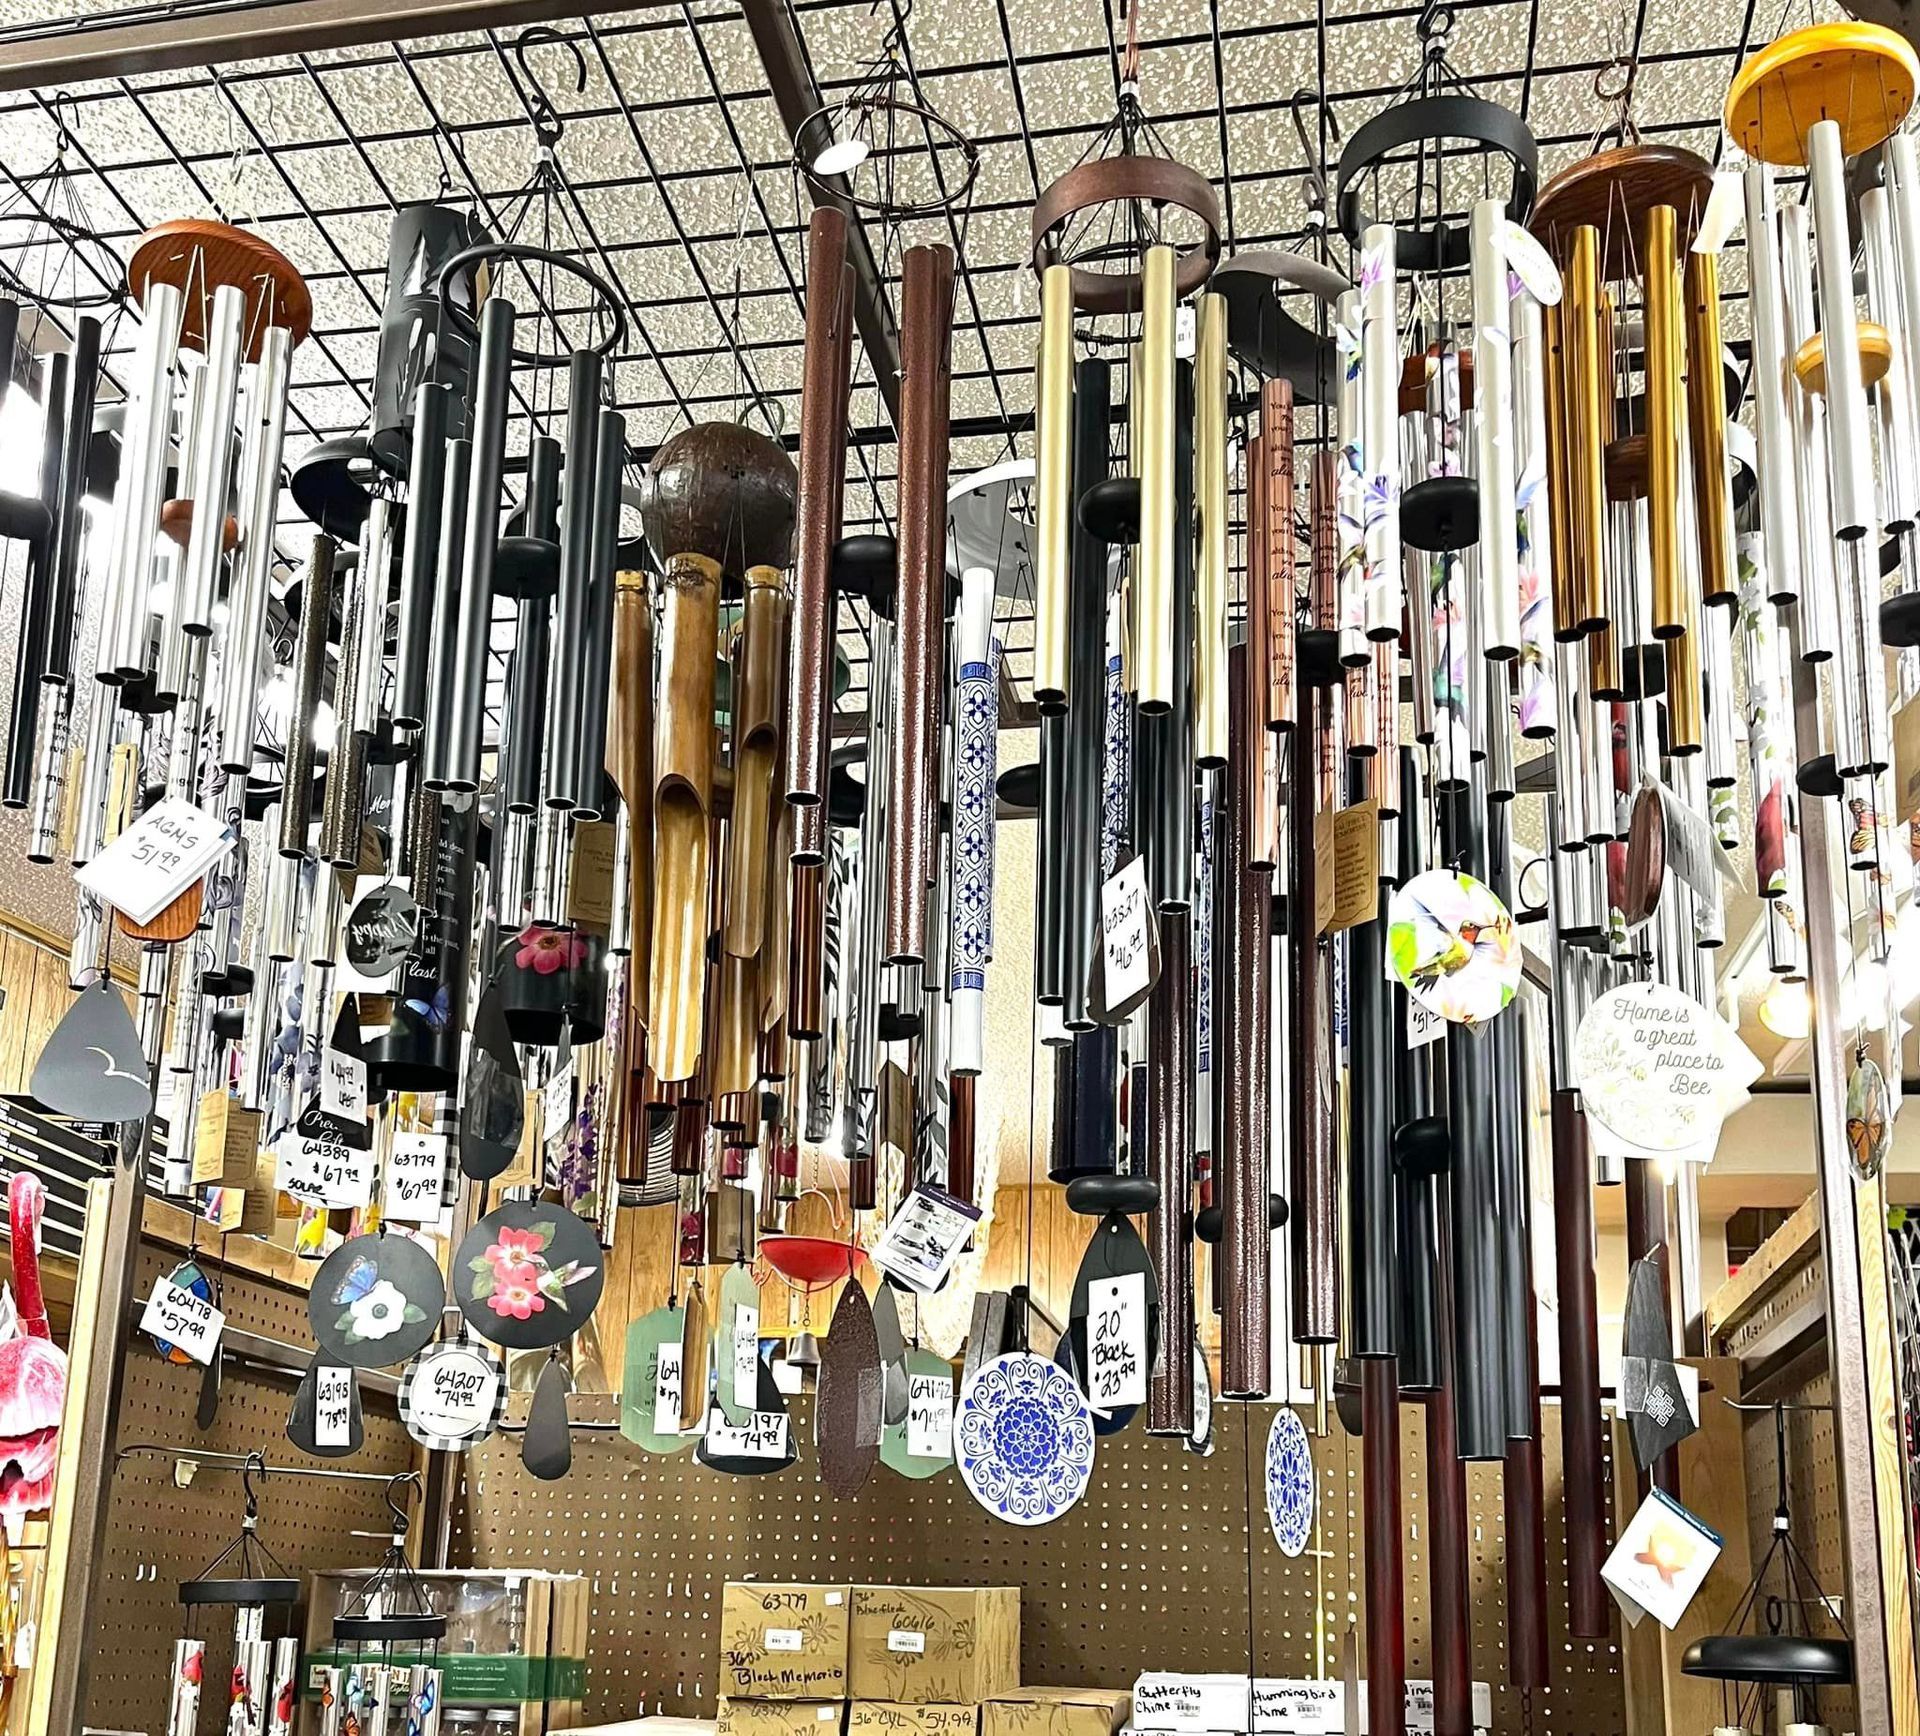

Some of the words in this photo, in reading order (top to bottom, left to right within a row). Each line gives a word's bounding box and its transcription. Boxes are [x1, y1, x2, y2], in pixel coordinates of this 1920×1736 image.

[147, 815, 199, 849] AGMS
[408, 961, 437, 979] last
[1613, 998, 1672, 1025] Home
[1674, 1007, 1690, 1023] is
[1633, 1028, 1647, 1043] a
[1647, 1028, 1698, 1051] great
[1654, 1050, 1704, 1072] place
[1704, 1053, 1725, 1070] to
[302, 1140, 351, 1163] 64389
[394, 1154, 436, 1168] 63779
[167, 1287, 212, 1321] 60478
[1091, 1341, 1136, 1366] Black
[434, 1367, 485, 1393] 64207
[318, 1381, 349, 1403] 63198
[762, 1592, 807, 1611] 63779
[892, 1613, 935, 1631] 60616
[1139, 1686, 1202, 1699] Butterfly
[1135, 1701, 1171, 1714] Chime
